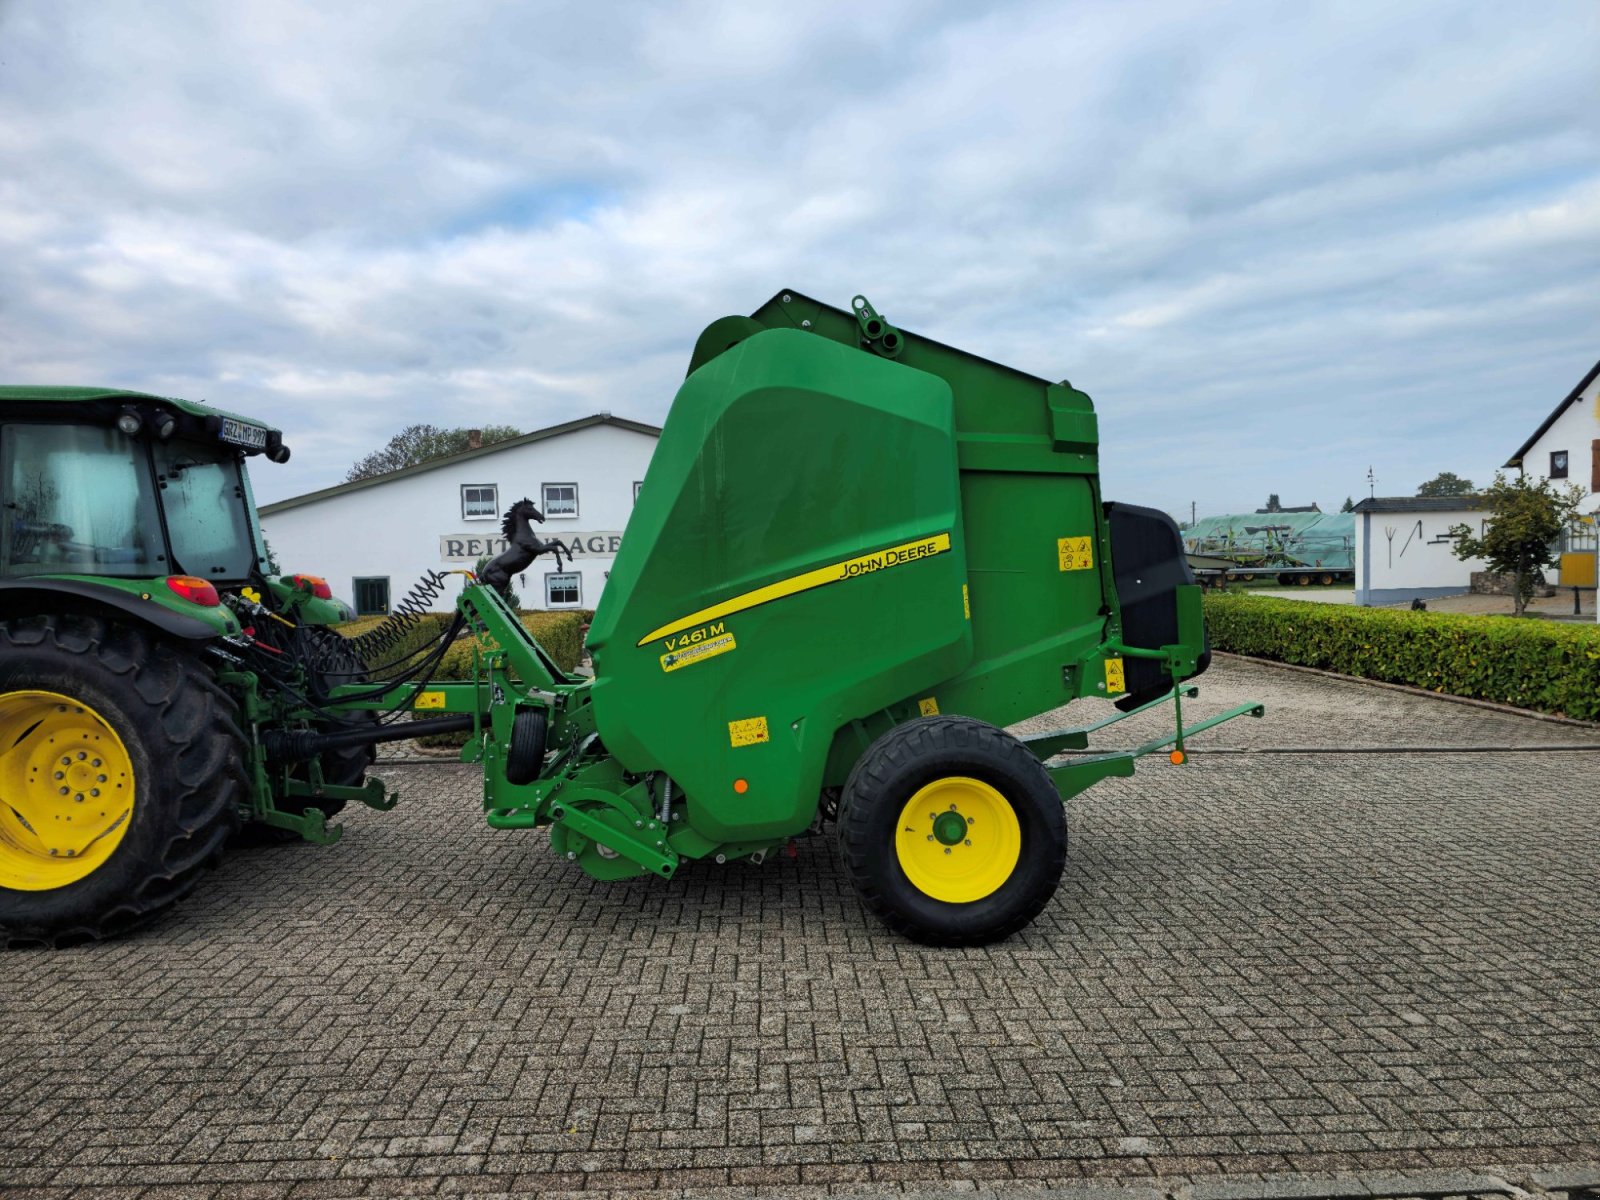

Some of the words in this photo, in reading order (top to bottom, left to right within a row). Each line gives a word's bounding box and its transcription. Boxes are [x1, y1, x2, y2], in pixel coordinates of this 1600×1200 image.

[839, 557, 883, 579] JOHN
[885, 542, 937, 566] DEERE
[664, 638, 676, 651] V
[678, 628, 707, 646] 461
[709, 622, 725, 636] M
